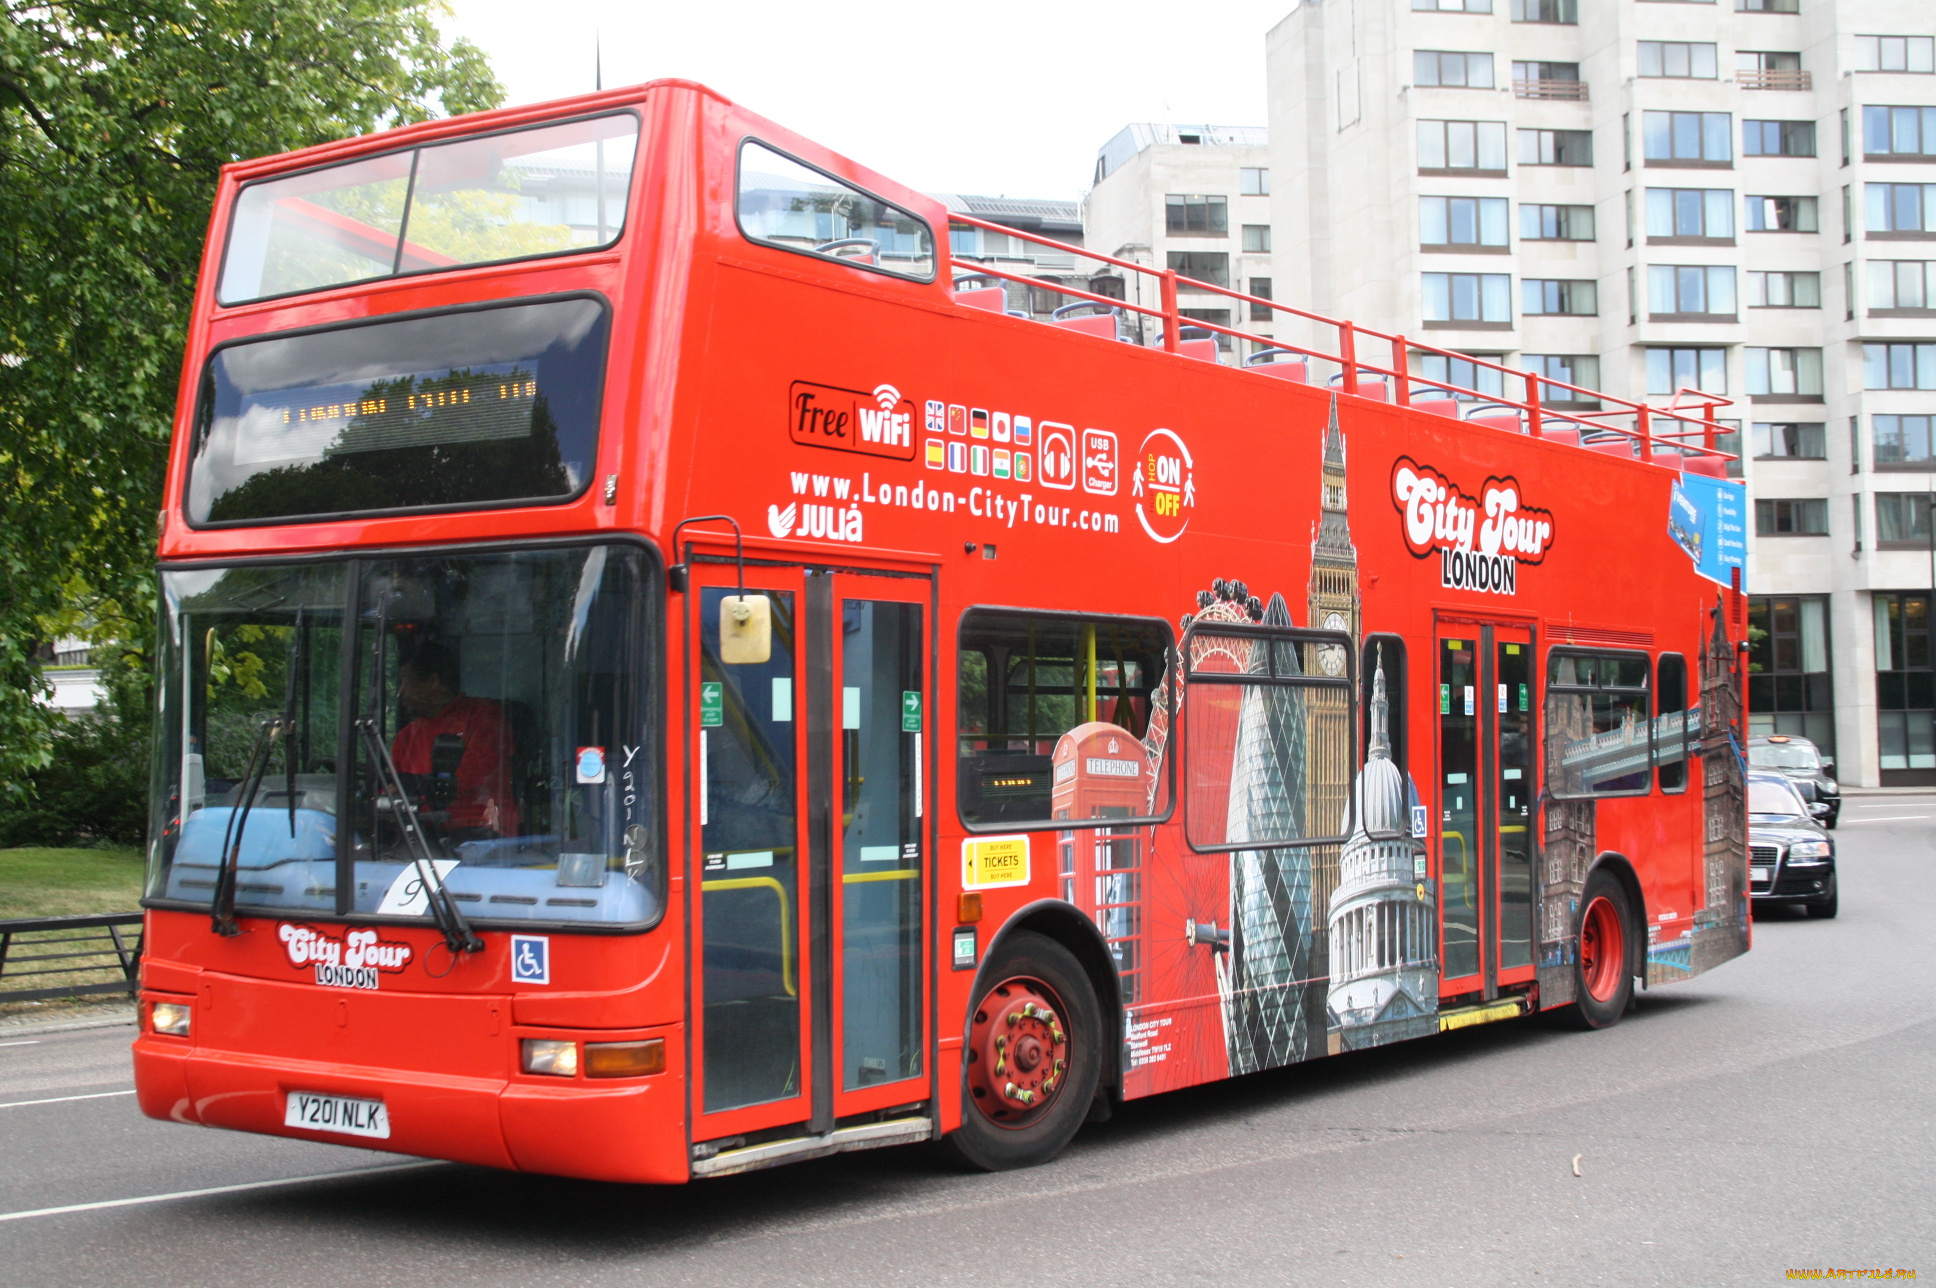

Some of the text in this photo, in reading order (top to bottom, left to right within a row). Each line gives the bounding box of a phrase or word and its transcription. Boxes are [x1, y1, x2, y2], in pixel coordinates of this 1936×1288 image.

[796, 392, 910, 447] Free WiFi
[1091, 437, 1110, 451] USB
[1088, 476, 1113, 490] Charger
[1148, 453, 1180, 485] HOP ON
[790, 471, 1119, 533] www.London-CityTour.com
[1155, 492, 1180, 517] OFF
[1395, 467, 1550, 555] City Tour
[1442, 547, 1516, 595] LONDON
[1088, 759, 1137, 775] TELEPHONE
[984, 855, 1019, 868] TICKETS
[279, 924, 411, 968] City Tour
[315, 963, 379, 989] LONDON
[1131, 1018, 1171, 1031] LONDON CITY TOUR
[299, 1096, 380, 1130] Y201 NLK
